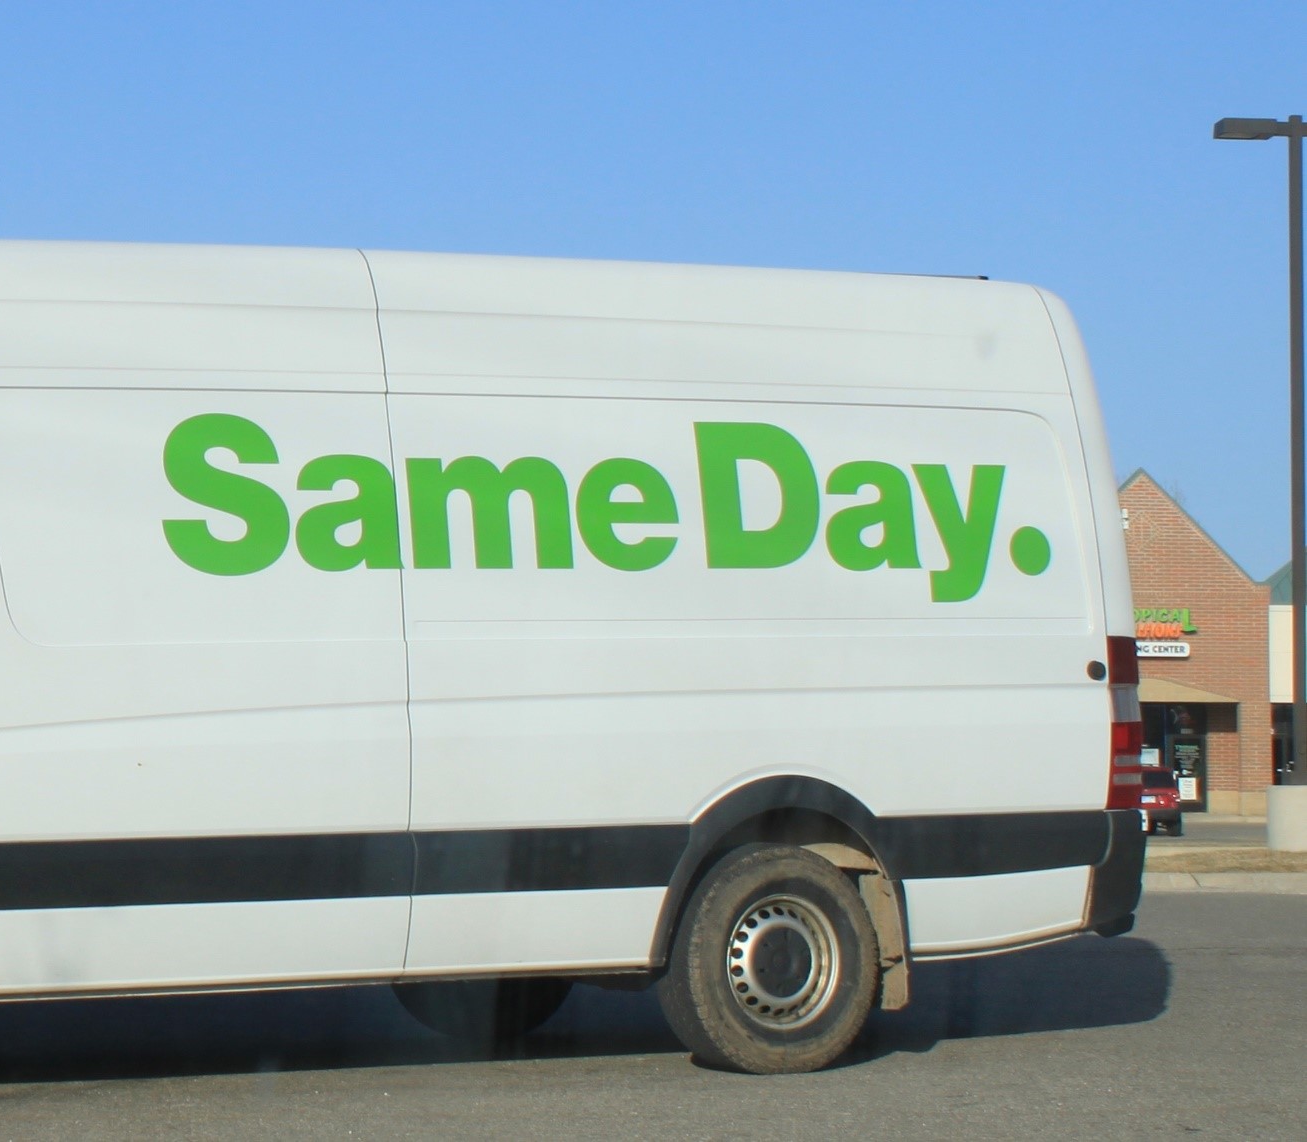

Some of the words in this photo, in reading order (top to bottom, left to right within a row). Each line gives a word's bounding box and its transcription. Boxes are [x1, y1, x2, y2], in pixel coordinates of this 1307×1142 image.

[162, 412, 679, 577] Same
[693, 421, 1052, 603] Day.
[1152, 645, 1186, 654] CENTER
